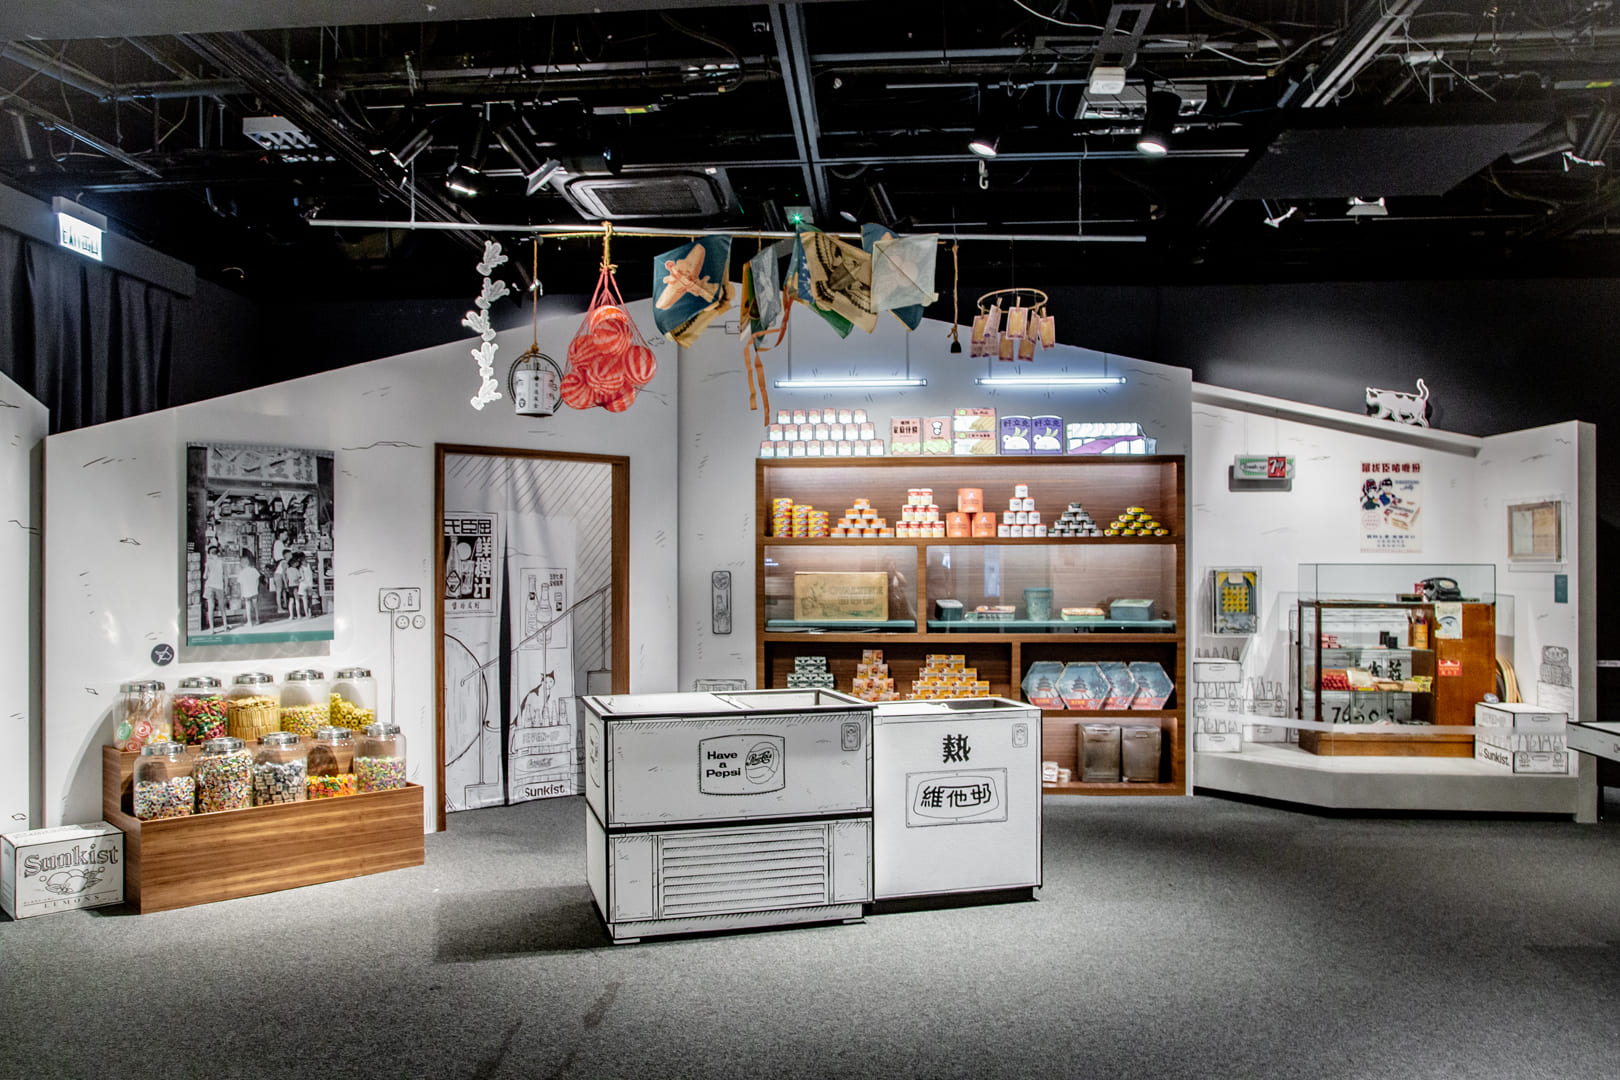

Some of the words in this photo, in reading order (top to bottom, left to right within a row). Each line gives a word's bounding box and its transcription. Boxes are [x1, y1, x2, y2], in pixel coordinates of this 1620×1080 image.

[474, 537, 491, 598] 鮮橙汁
[707, 751, 738, 760] Have
[942, 734, 971, 763] 熱
[1483, 748, 1509, 766] Sunkist
[706, 768, 741, 778] Pepsi
[524, 783, 565, 798] Sunkist
[920, 783, 992, 808] 維他奶
[24, 843, 119, 878] Sunkist
